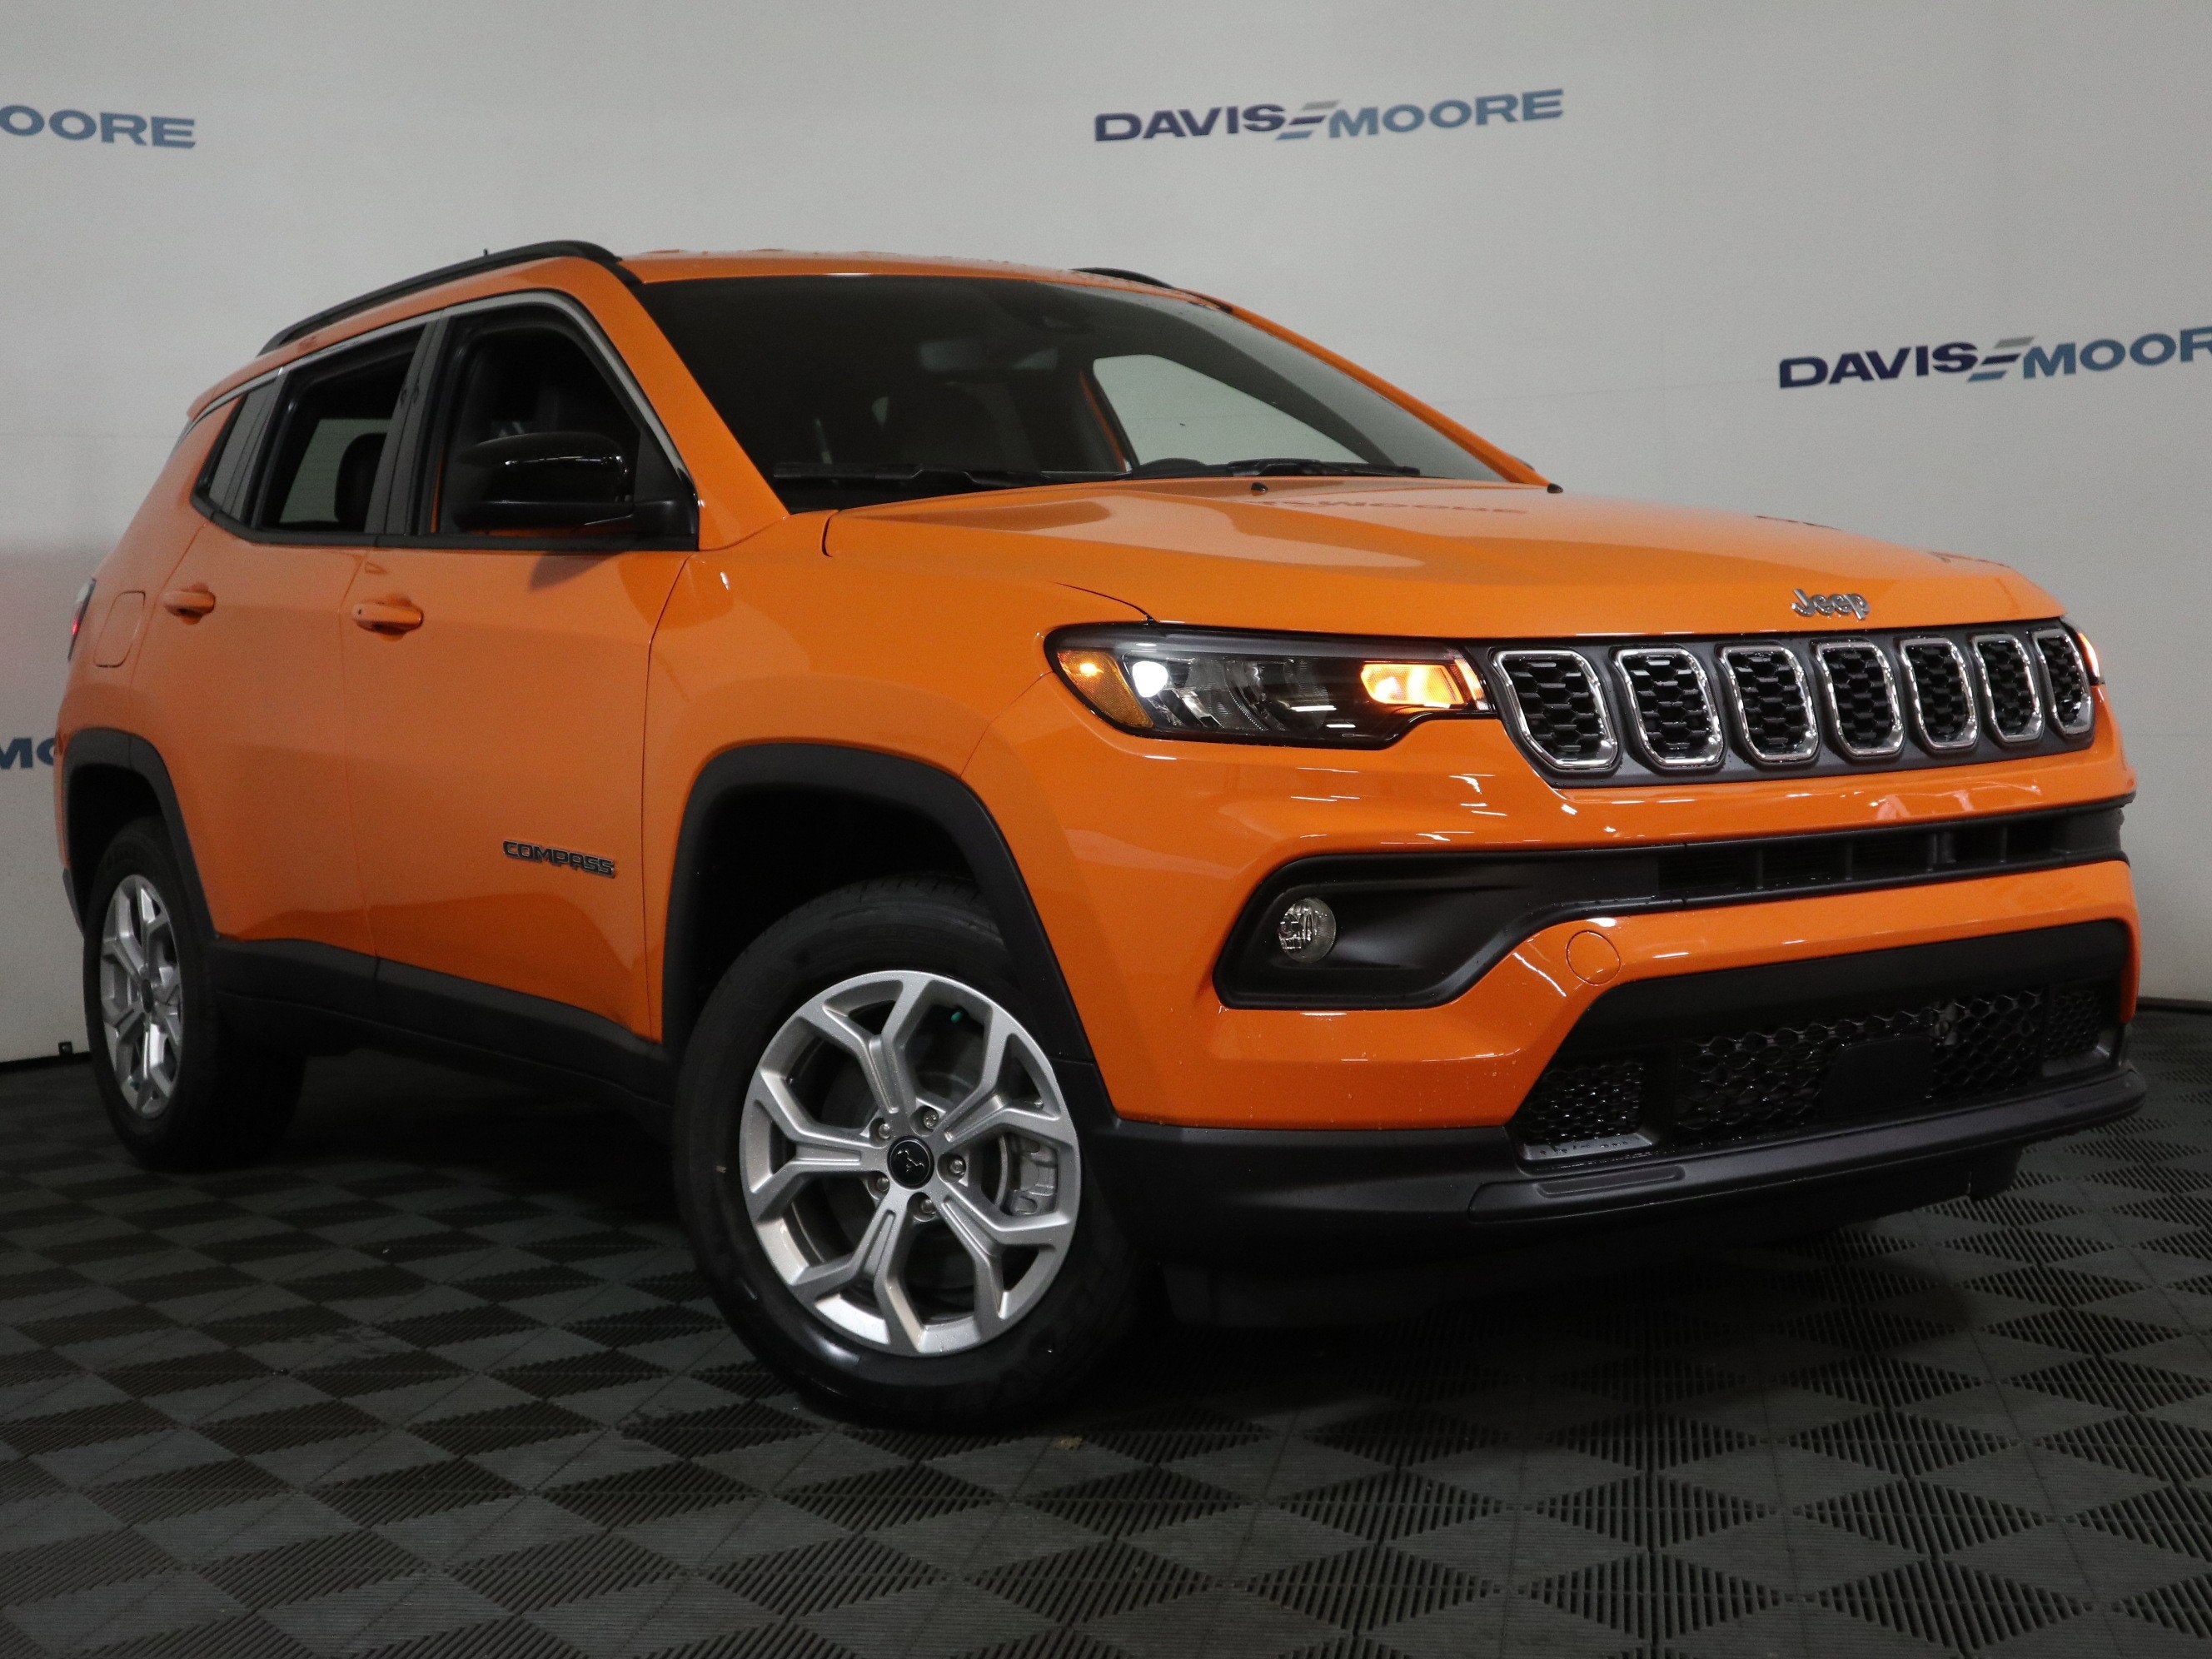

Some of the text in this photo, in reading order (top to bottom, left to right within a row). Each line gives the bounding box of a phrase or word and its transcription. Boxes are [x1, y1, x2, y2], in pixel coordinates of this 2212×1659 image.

[1095, 89, 1563, 141] DAVIS MOORE
[1779, 341, 1979, 388] DAVIS
[1791, 588, 1871, 620] Jeep
[503, 839, 615, 879] COMPASS
